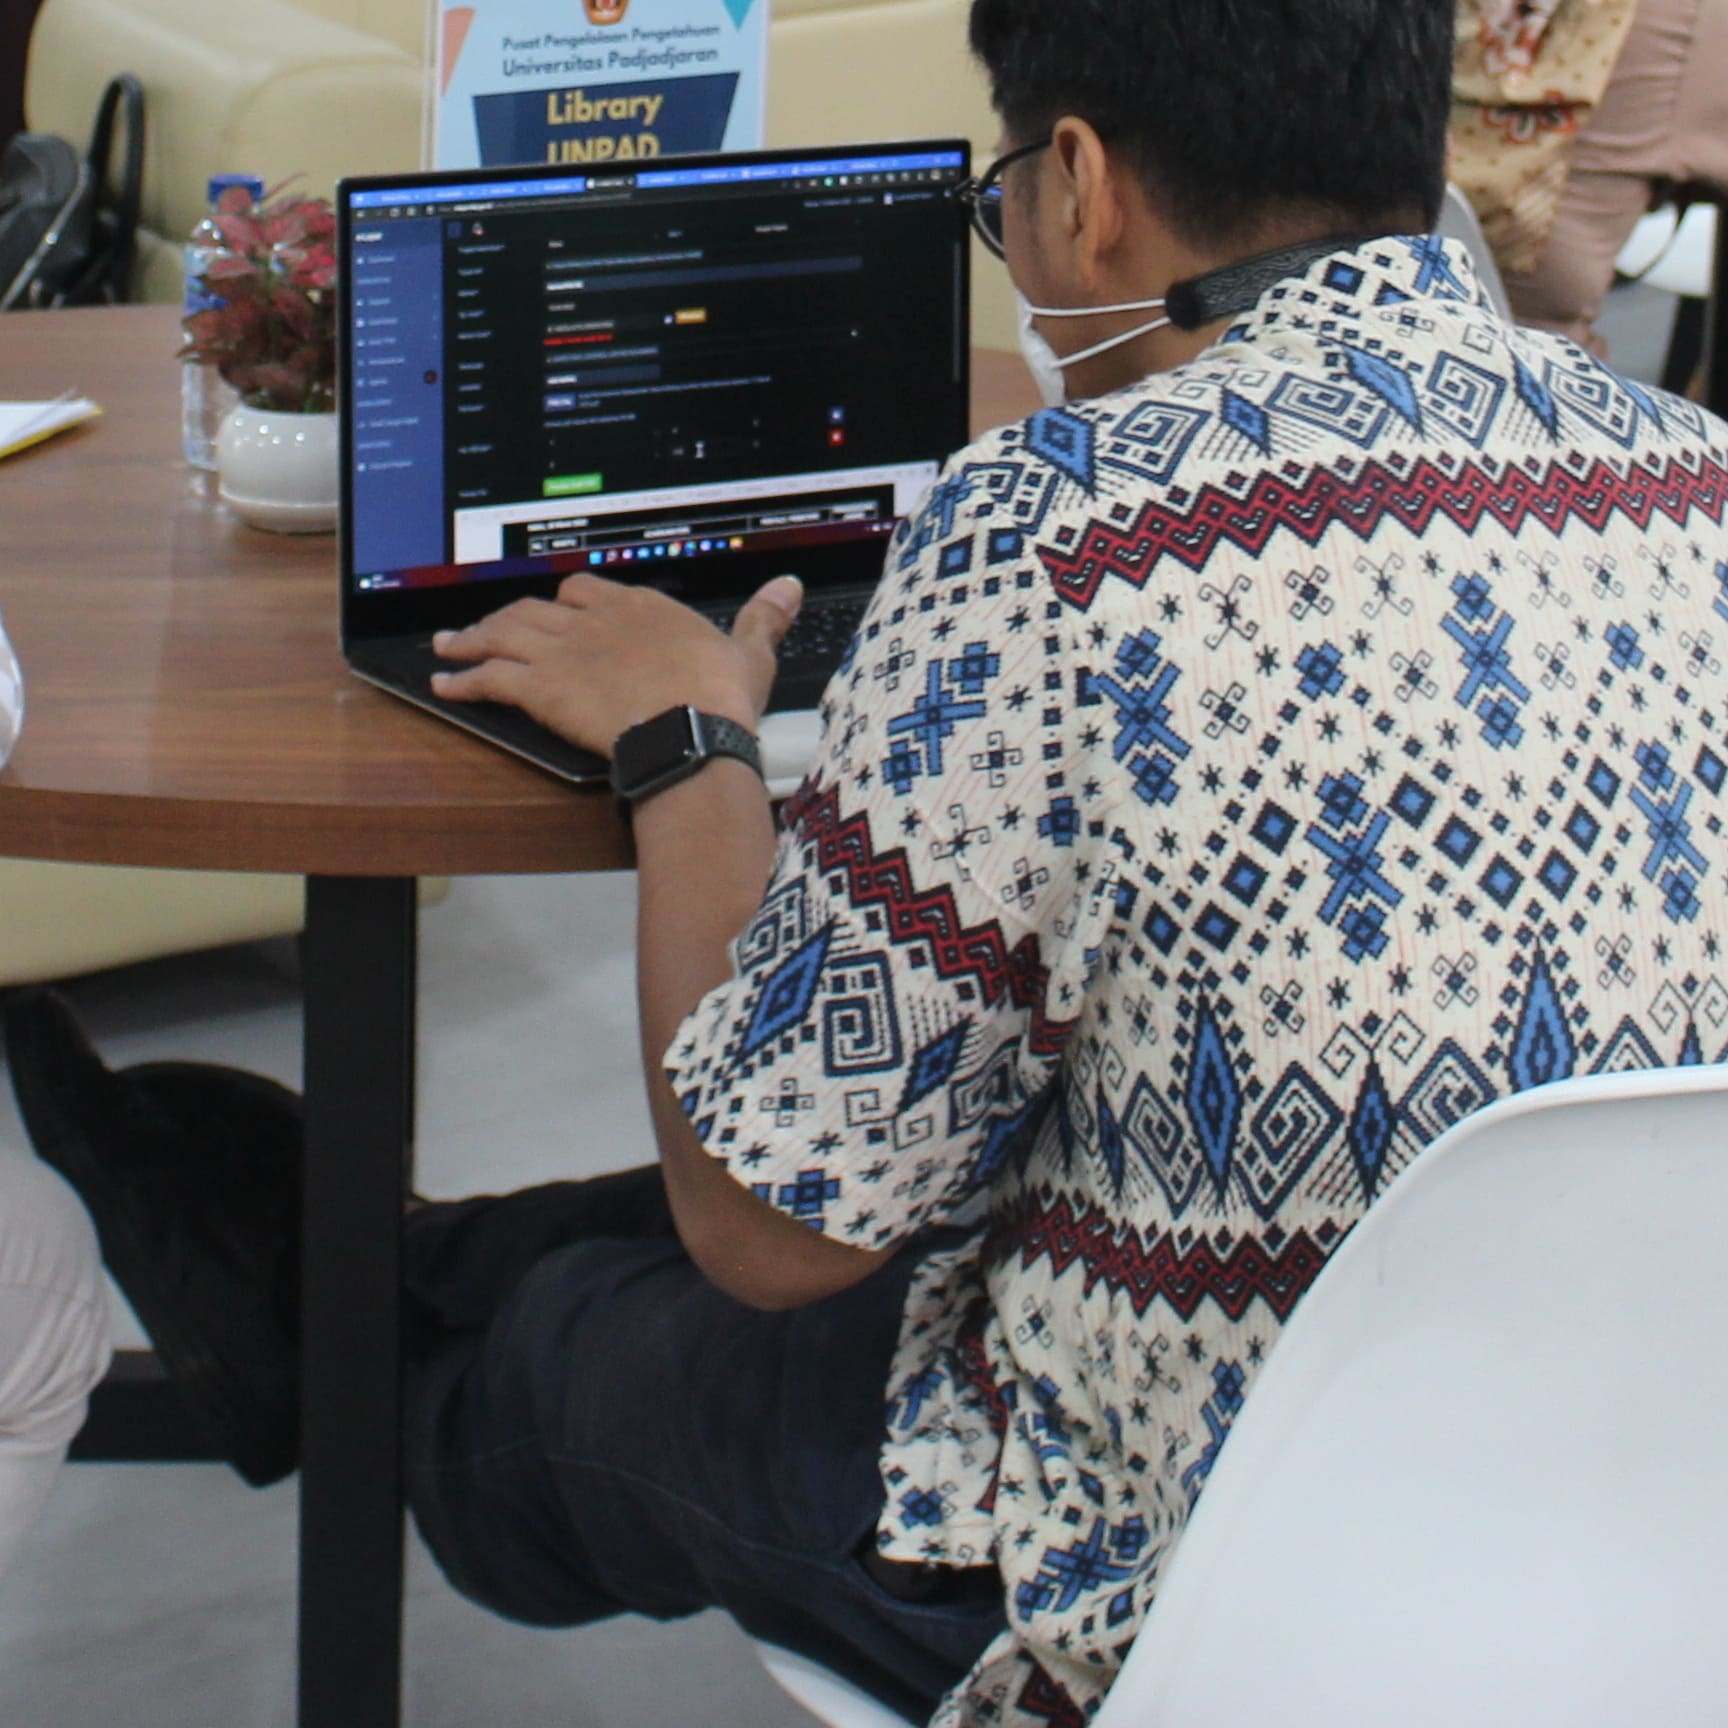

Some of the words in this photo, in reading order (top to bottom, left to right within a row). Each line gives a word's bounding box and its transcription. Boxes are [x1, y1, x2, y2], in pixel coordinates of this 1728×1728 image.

[503, 54, 602, 76] Universitas
[608, 47, 718, 70] Padjadjaran
[547, 90, 663, 126] Library
[547, 133, 660, 165] UNPAD
